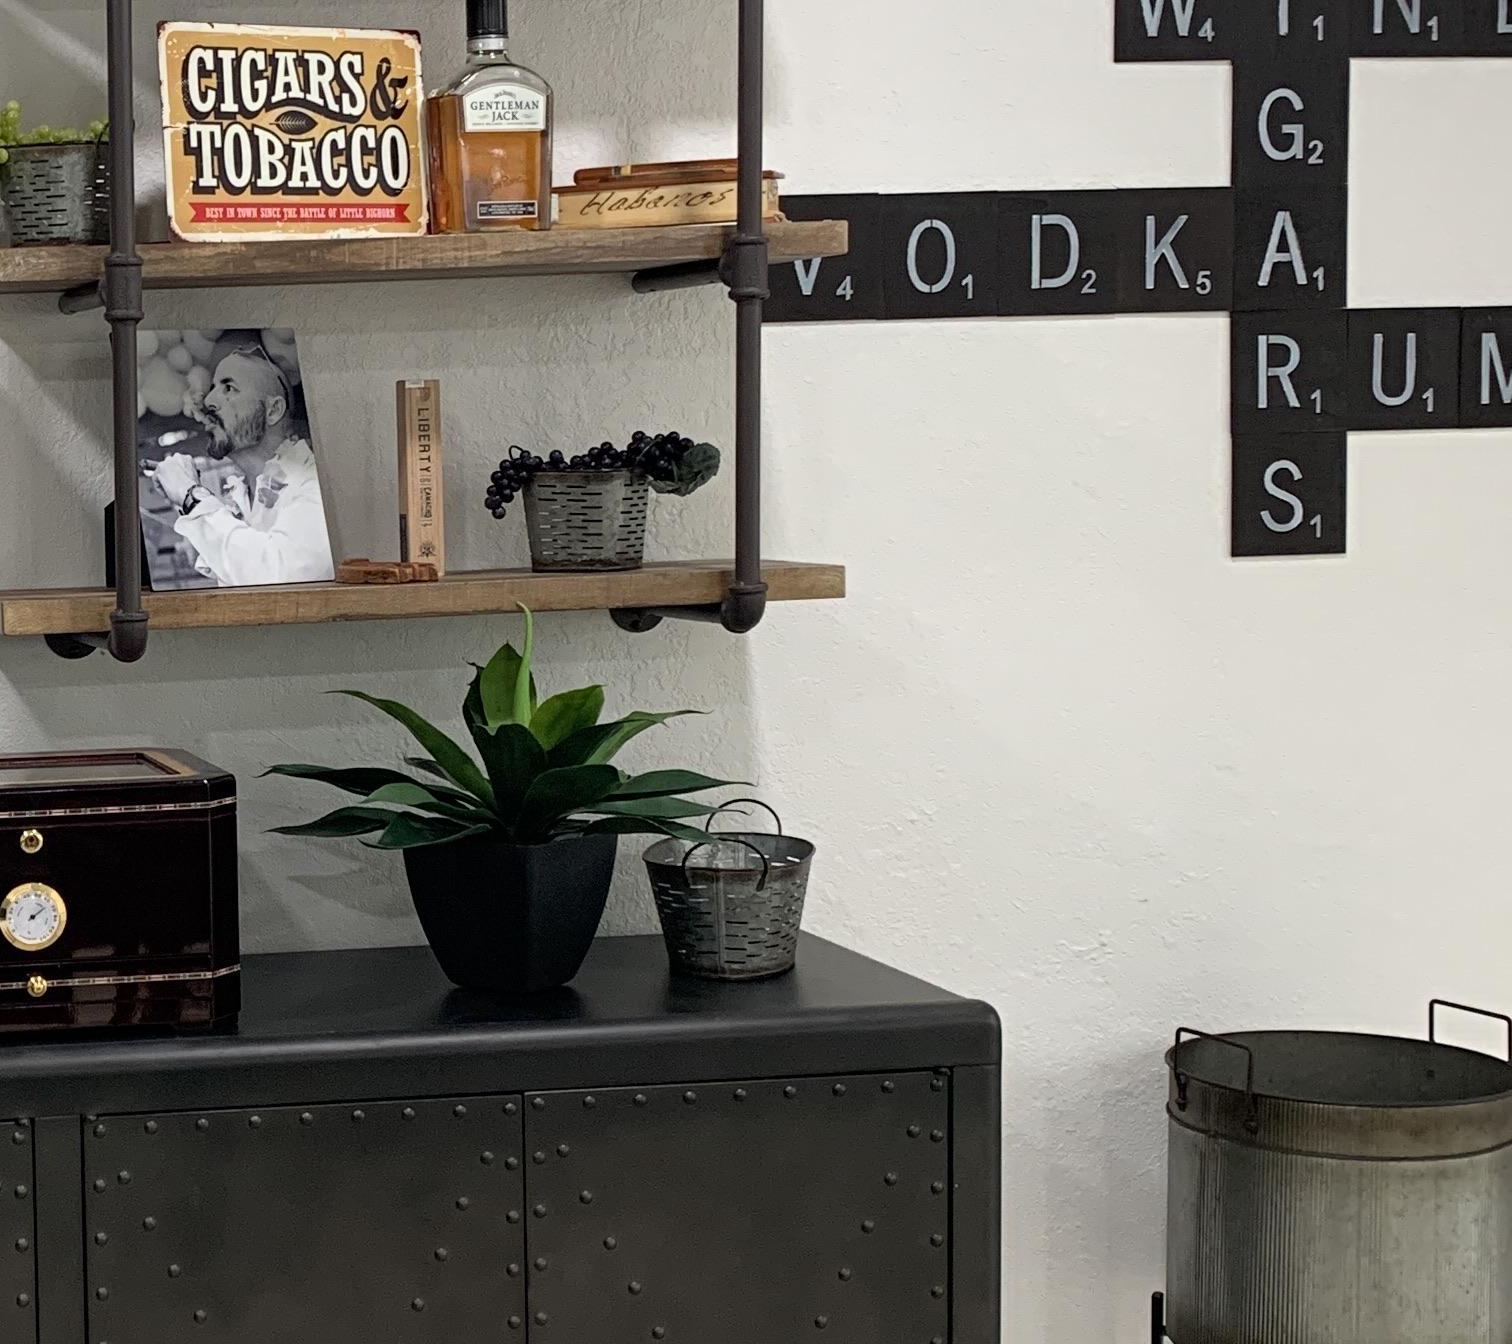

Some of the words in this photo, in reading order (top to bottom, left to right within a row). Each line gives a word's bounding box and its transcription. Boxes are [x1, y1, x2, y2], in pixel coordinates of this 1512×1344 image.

[182, 45, 368, 123] CIGARS
[370, 57, 408, 121] &
[470, 100, 540, 111] GENTLEMAN
[491, 111, 520, 122] JACK
[184, 120, 410, 196] TOBACCO
[205, 207, 224, 218] BEST
[226, 207, 235, 218] IN
[236, 207, 258, 218] TOWN
[260, 207, 281, 218] SINCE
[283, 207, 297, 220] THE
[300, 207, 326, 218] BATTLE
[328, 207, 337, 218] OF
[339, 207, 364, 218] LITTLE
[365, 207, 396, 218] BIGHORN
[580, 186, 735, 216] Habanos
[417, 407, 432, 473] LIBERTY
